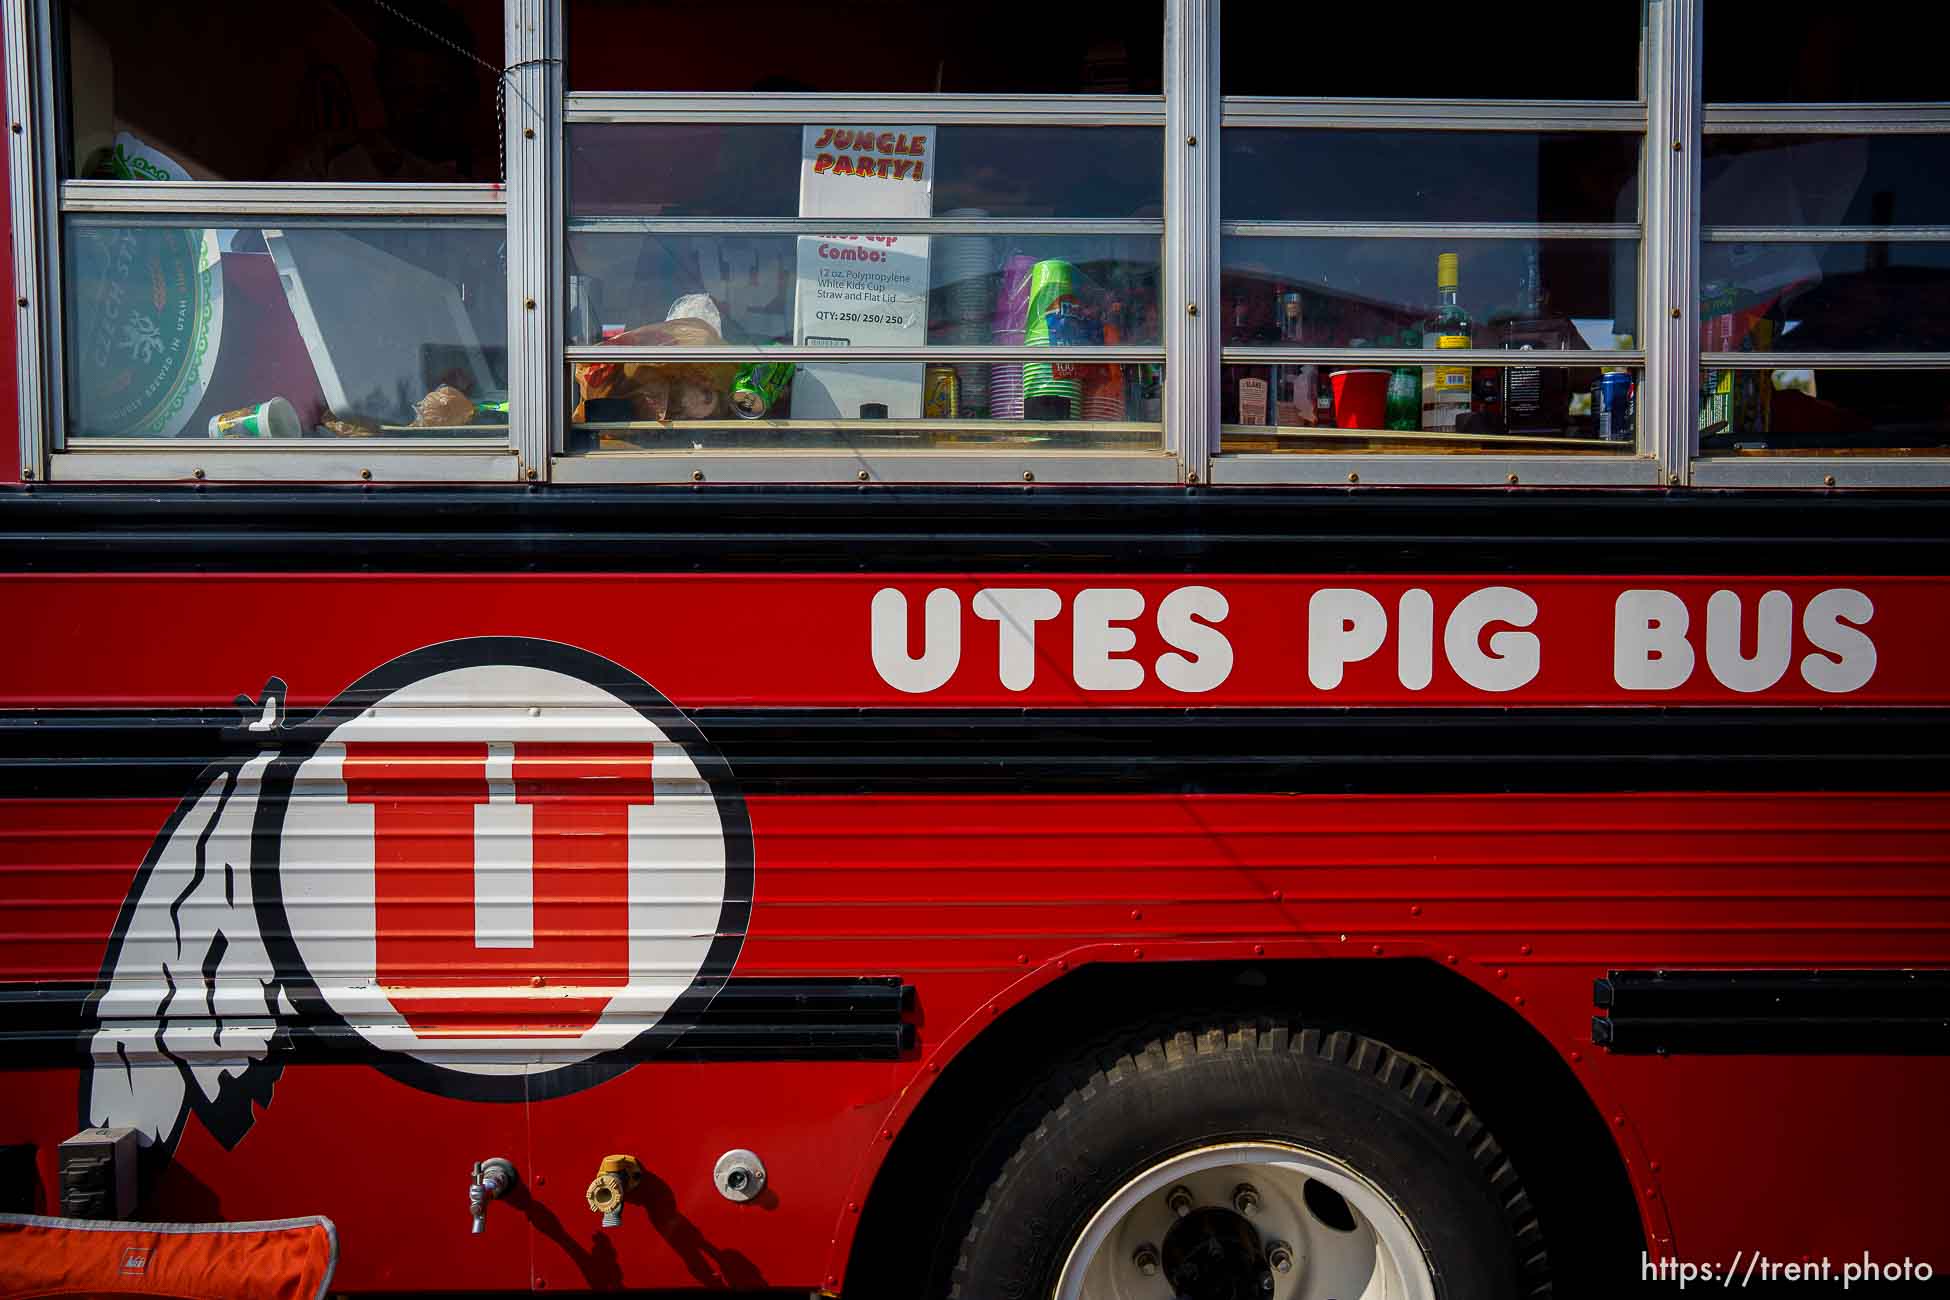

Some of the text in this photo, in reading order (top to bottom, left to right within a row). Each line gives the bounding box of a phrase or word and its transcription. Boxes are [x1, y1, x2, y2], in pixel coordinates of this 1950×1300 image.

[815, 128, 928, 156] JUNGLE
[814, 153, 925, 182] PARTY!
[818, 243, 887, 263] Combo:
[817, 279, 886, 293] White Kids Cup
[819, 268, 911, 284] 12 oz. Polypropylene
[817, 289, 897, 303] Straw and Flat Lid
[176, 299, 188, 332] UTAH
[816, 311, 904, 325] QTY: 250/ 250/ 250
[871, 586, 1878, 693] UTES PIG BUS
[342, 741, 655, 1040] U
